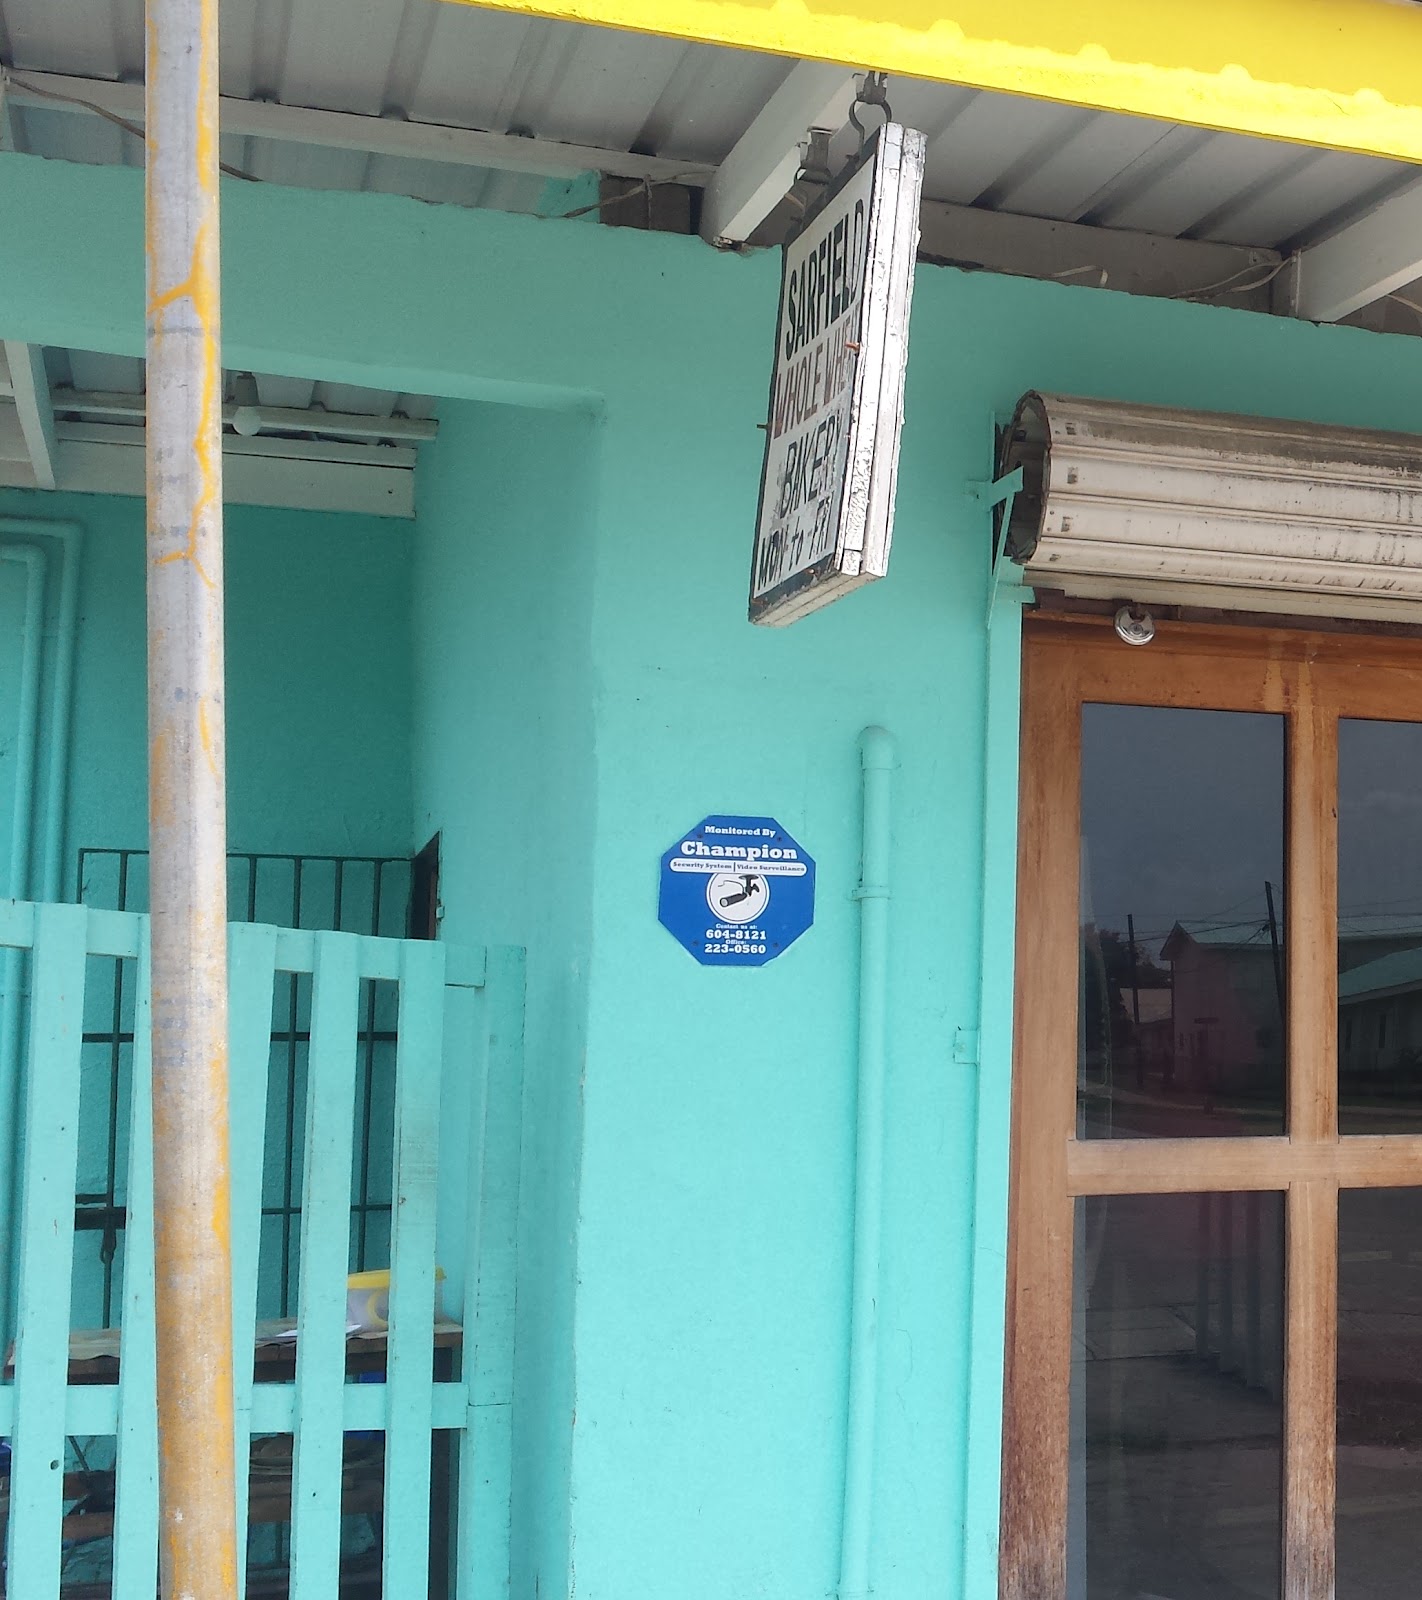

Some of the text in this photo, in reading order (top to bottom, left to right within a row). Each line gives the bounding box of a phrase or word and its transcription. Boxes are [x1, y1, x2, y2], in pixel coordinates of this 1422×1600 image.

[786, 199, 864, 361] SARFIELD
[773, 342, 823, 439] WHOLE
[780, 409, 844, 519] BAKERY
[705, 826, 776, 838] Monitored By
[681, 841, 798, 861] Champion
[673, 861, 704, 869] Security
[705, 861, 732, 869] System
[706, 929, 767, 940] 604-8121
[704, 943, 767, 954] 223-0560
